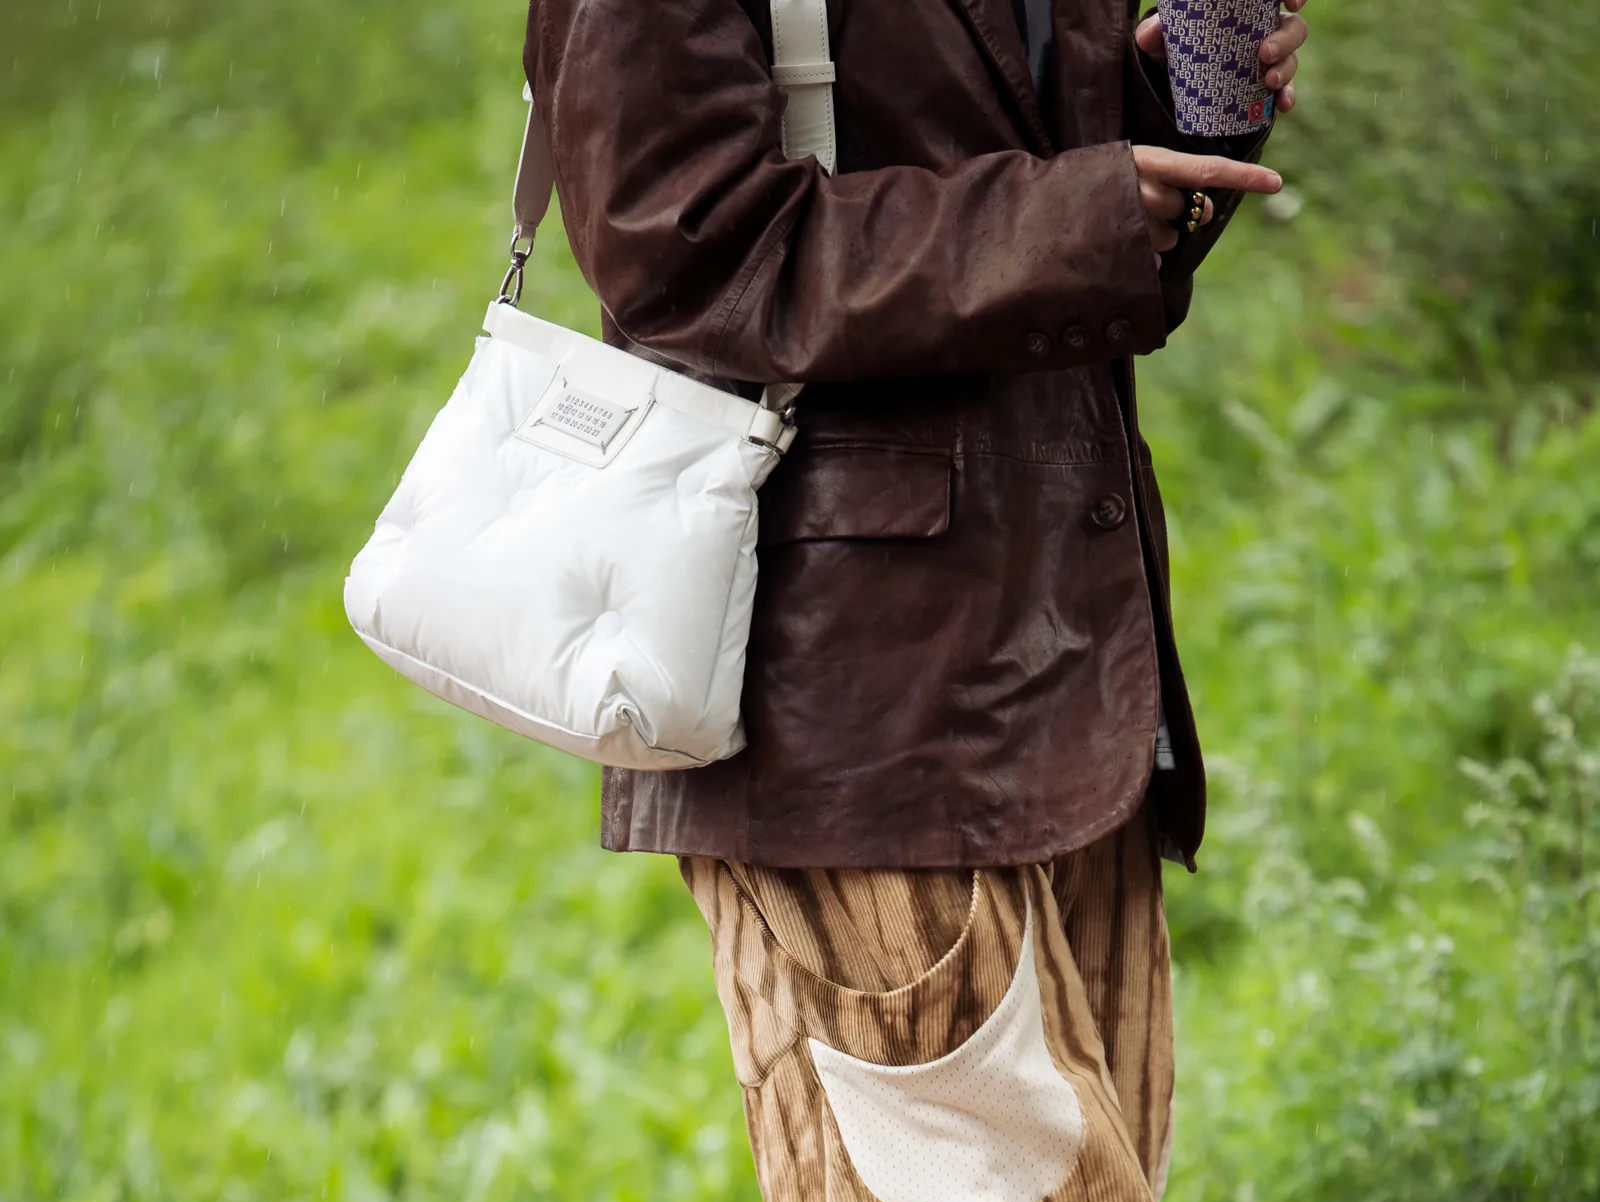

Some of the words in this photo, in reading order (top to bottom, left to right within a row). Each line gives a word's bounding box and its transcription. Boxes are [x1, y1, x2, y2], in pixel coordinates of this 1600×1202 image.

[1187, 2, 1213, 11] FED
[1204, 10, 1230, 20] FED
[1234, 1, 1275, 18] ENERGI
[1175, 18, 1219, 28] ENERGI
[1237, 14, 1260, 26] FED
[1168, 26, 1186, 36] FED
[1189, 27, 1236, 37] ENERGI
[1252, 20, 1270, 32] FED
[1180, 36, 1201, 46] FED
[1204, 33, 1250, 46] ENERGI
[1194, 45, 1217, 55] FED
[1209, 53, 1232, 63] FED
[1181, 61, 1221, 72] ENERGI
[1175, 69, 1192, 80] FED
[1194, 70, 1237, 80] ENERGI
[1186, 79, 1205, 89] FED
[1208, 77, 1250, 89] ENERGI
[1198, 88, 1219, 98] FED
[1212, 96, 1233, 106] FED
[1188, 105, 1224, 115] ENERGI
[1182, 112, 1197, 123] FED
[1199, 113, 1237, 123] ENERGI
[1192, 122, 1209, 132] FED
[1212, 120, 1250, 132] ENERGI
[564, 406, 572, 414] 11
